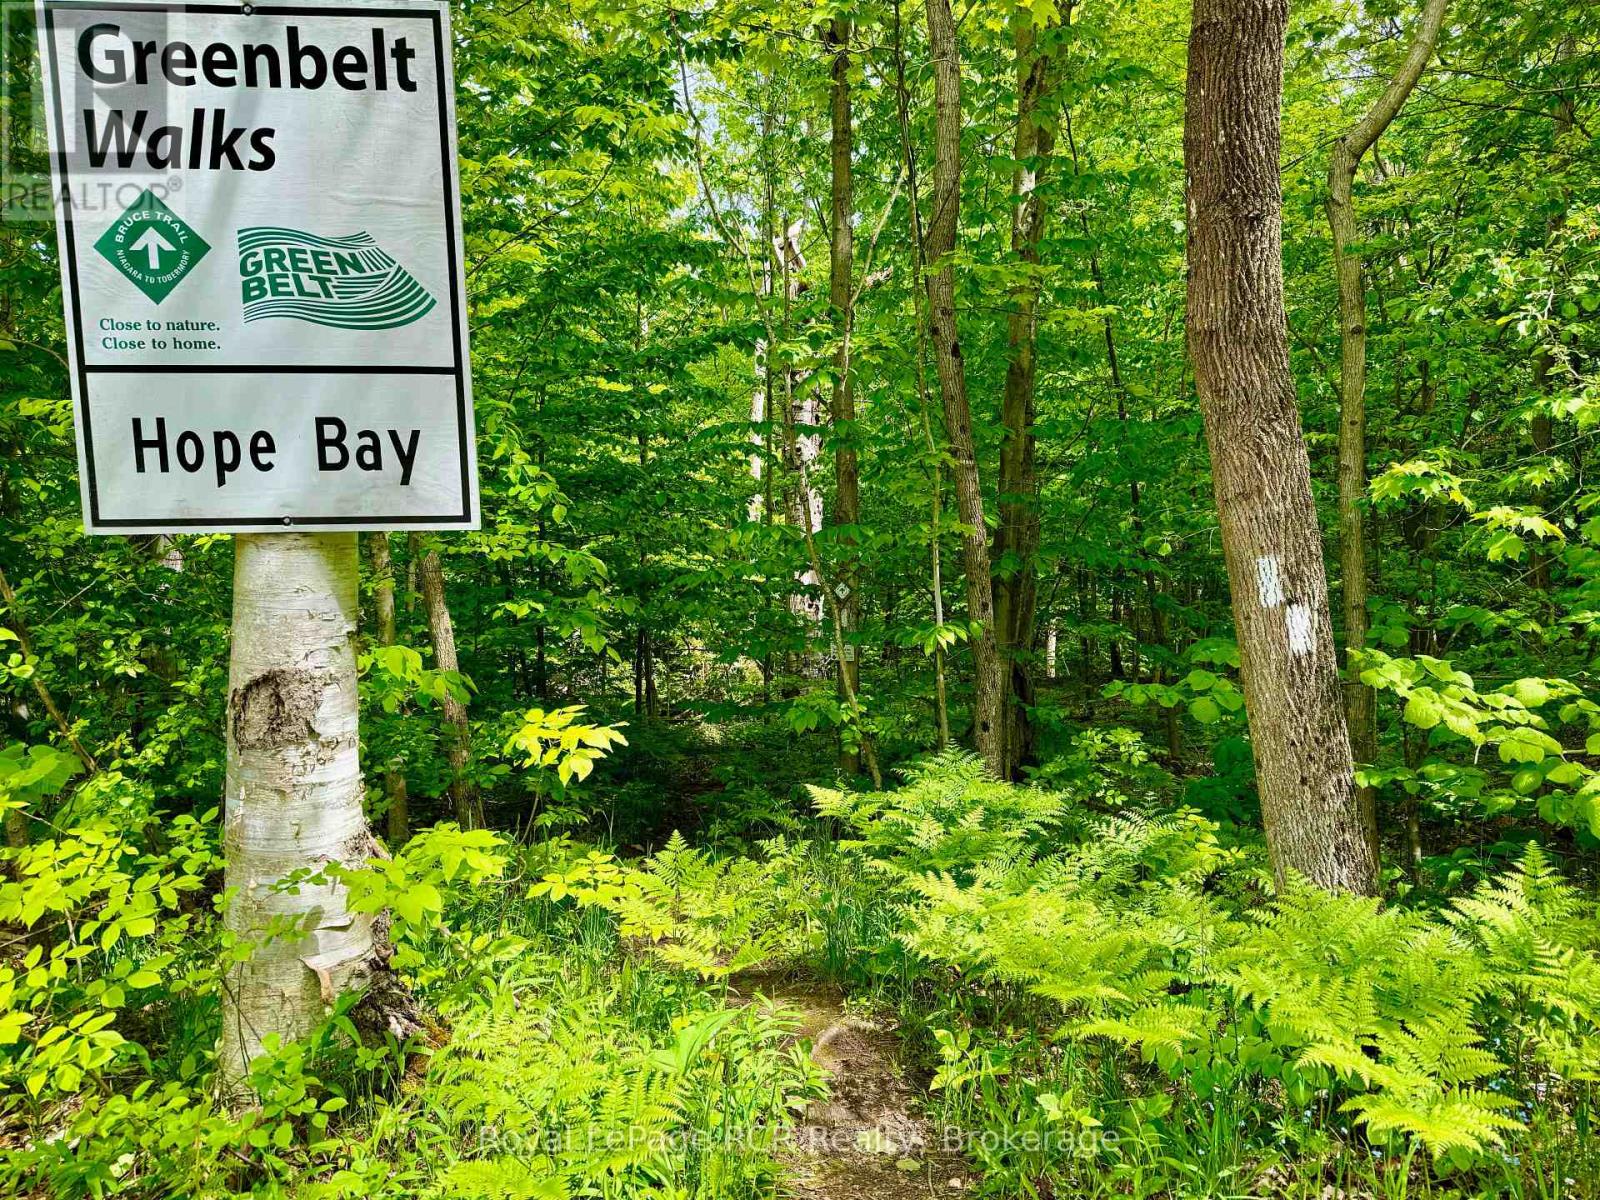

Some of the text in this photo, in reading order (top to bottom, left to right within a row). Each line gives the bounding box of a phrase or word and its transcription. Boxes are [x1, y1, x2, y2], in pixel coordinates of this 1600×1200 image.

[77, 23, 418, 93] Greenbelt
[83, 108, 277, 172] Walks
[115, 210, 189, 245] BRUCE TRAIL
[116, 249, 191, 284] NIAGARA TO TOBERMORY
[239, 247, 367, 278] GREEN
[241, 272, 334, 304] BELT
[99, 318, 221, 331] Close to nature.
[101, 336, 221, 350] Close to home.
[131, 416, 421, 488] Hope Bay
